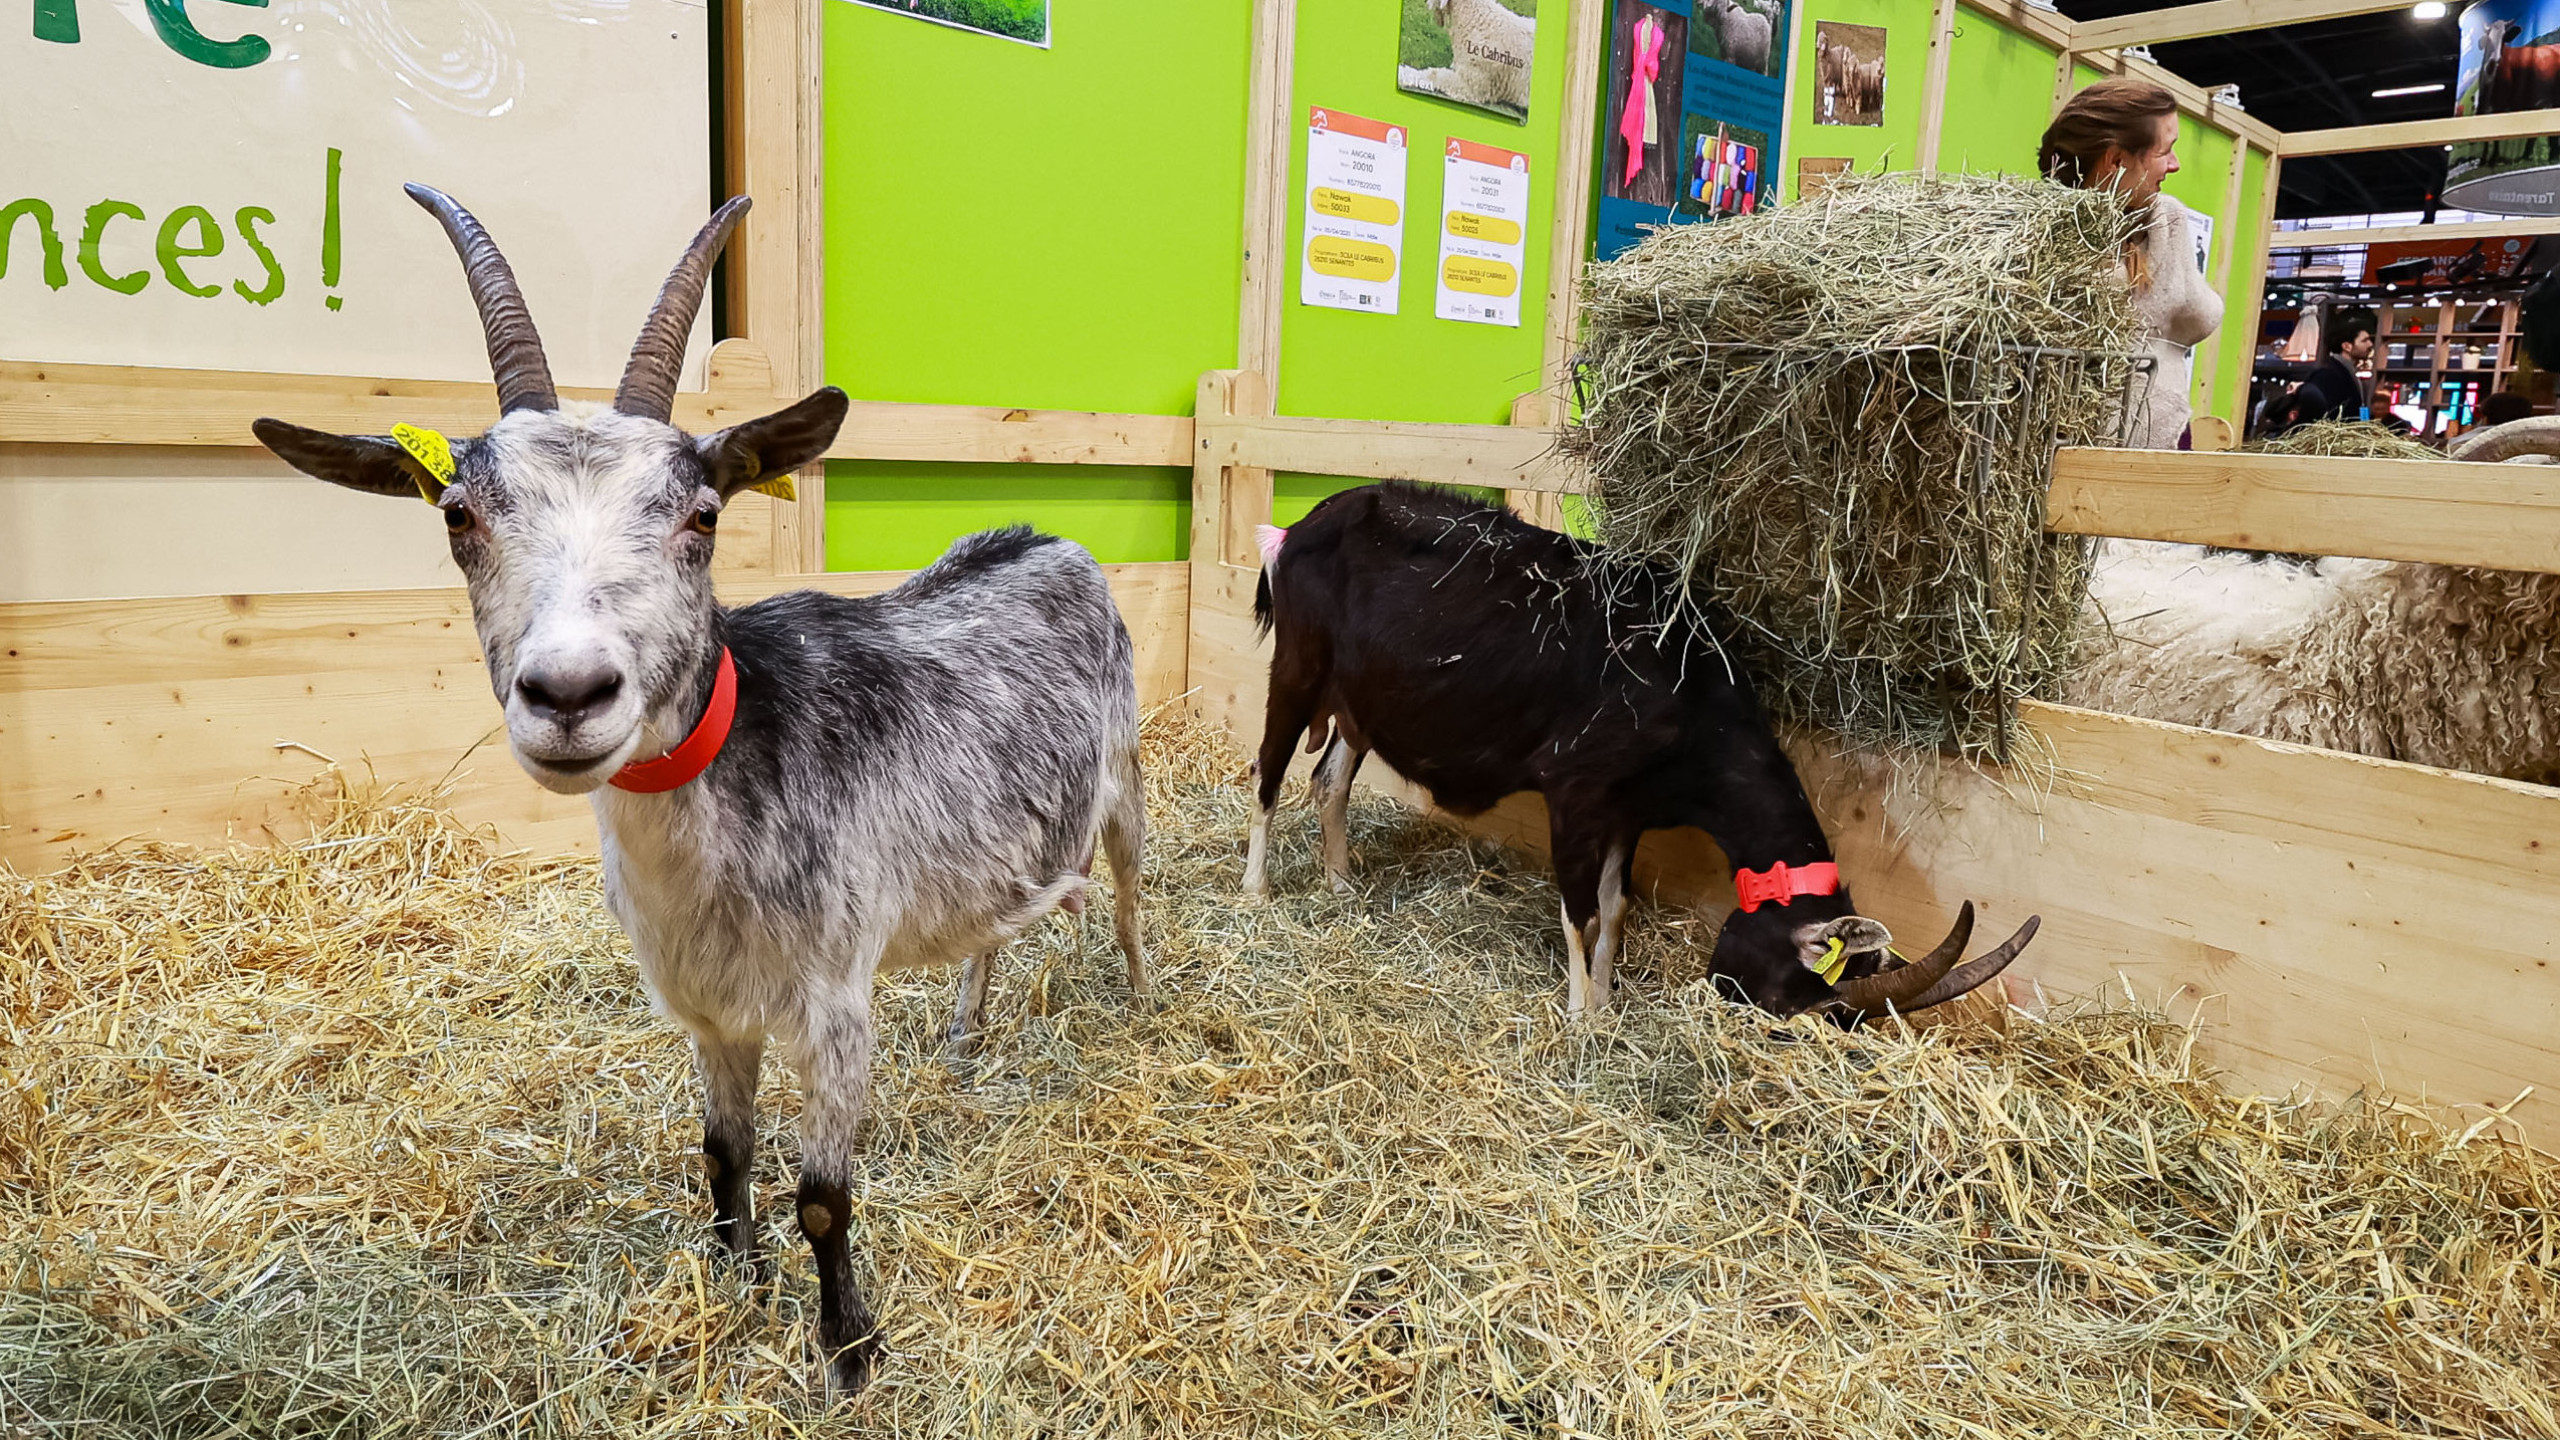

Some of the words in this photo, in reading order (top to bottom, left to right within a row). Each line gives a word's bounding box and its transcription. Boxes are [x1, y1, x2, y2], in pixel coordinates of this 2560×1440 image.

[1466, 40, 1480, 57] Le
[1481, 44, 1525, 69] Cabribus
[1350, 149, 1376, 161] ANGORA
[1352, 161, 1374, 173] 20010
